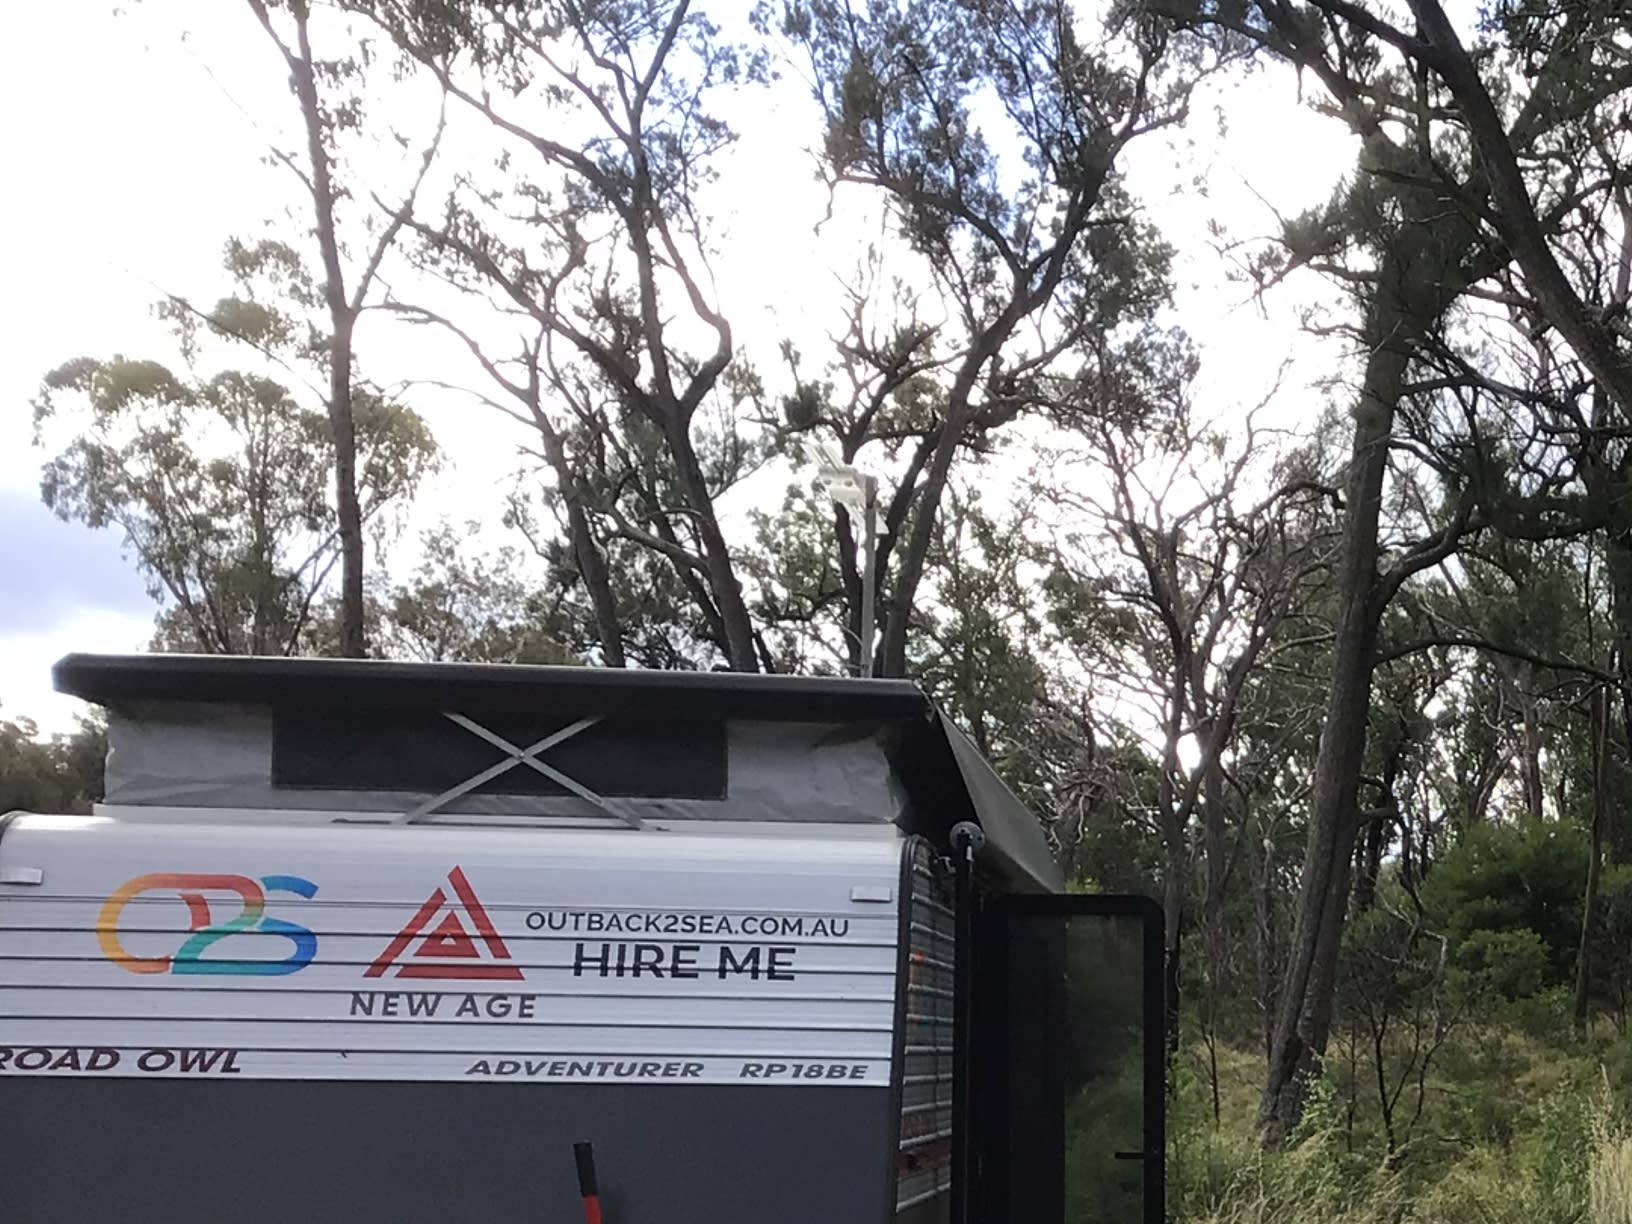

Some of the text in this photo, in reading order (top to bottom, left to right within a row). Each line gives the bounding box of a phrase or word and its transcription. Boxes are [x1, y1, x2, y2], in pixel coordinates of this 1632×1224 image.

[525, 911, 849, 938] OUTBACK2SEA.COM.AU
[573, 943, 797, 981] HIRE ME
[350, 991, 536, 1019] NEW AGE
[137, 1048, 241, 1073] OWL
[465, 1060, 869, 1080] ADVENTURER RP18BE
